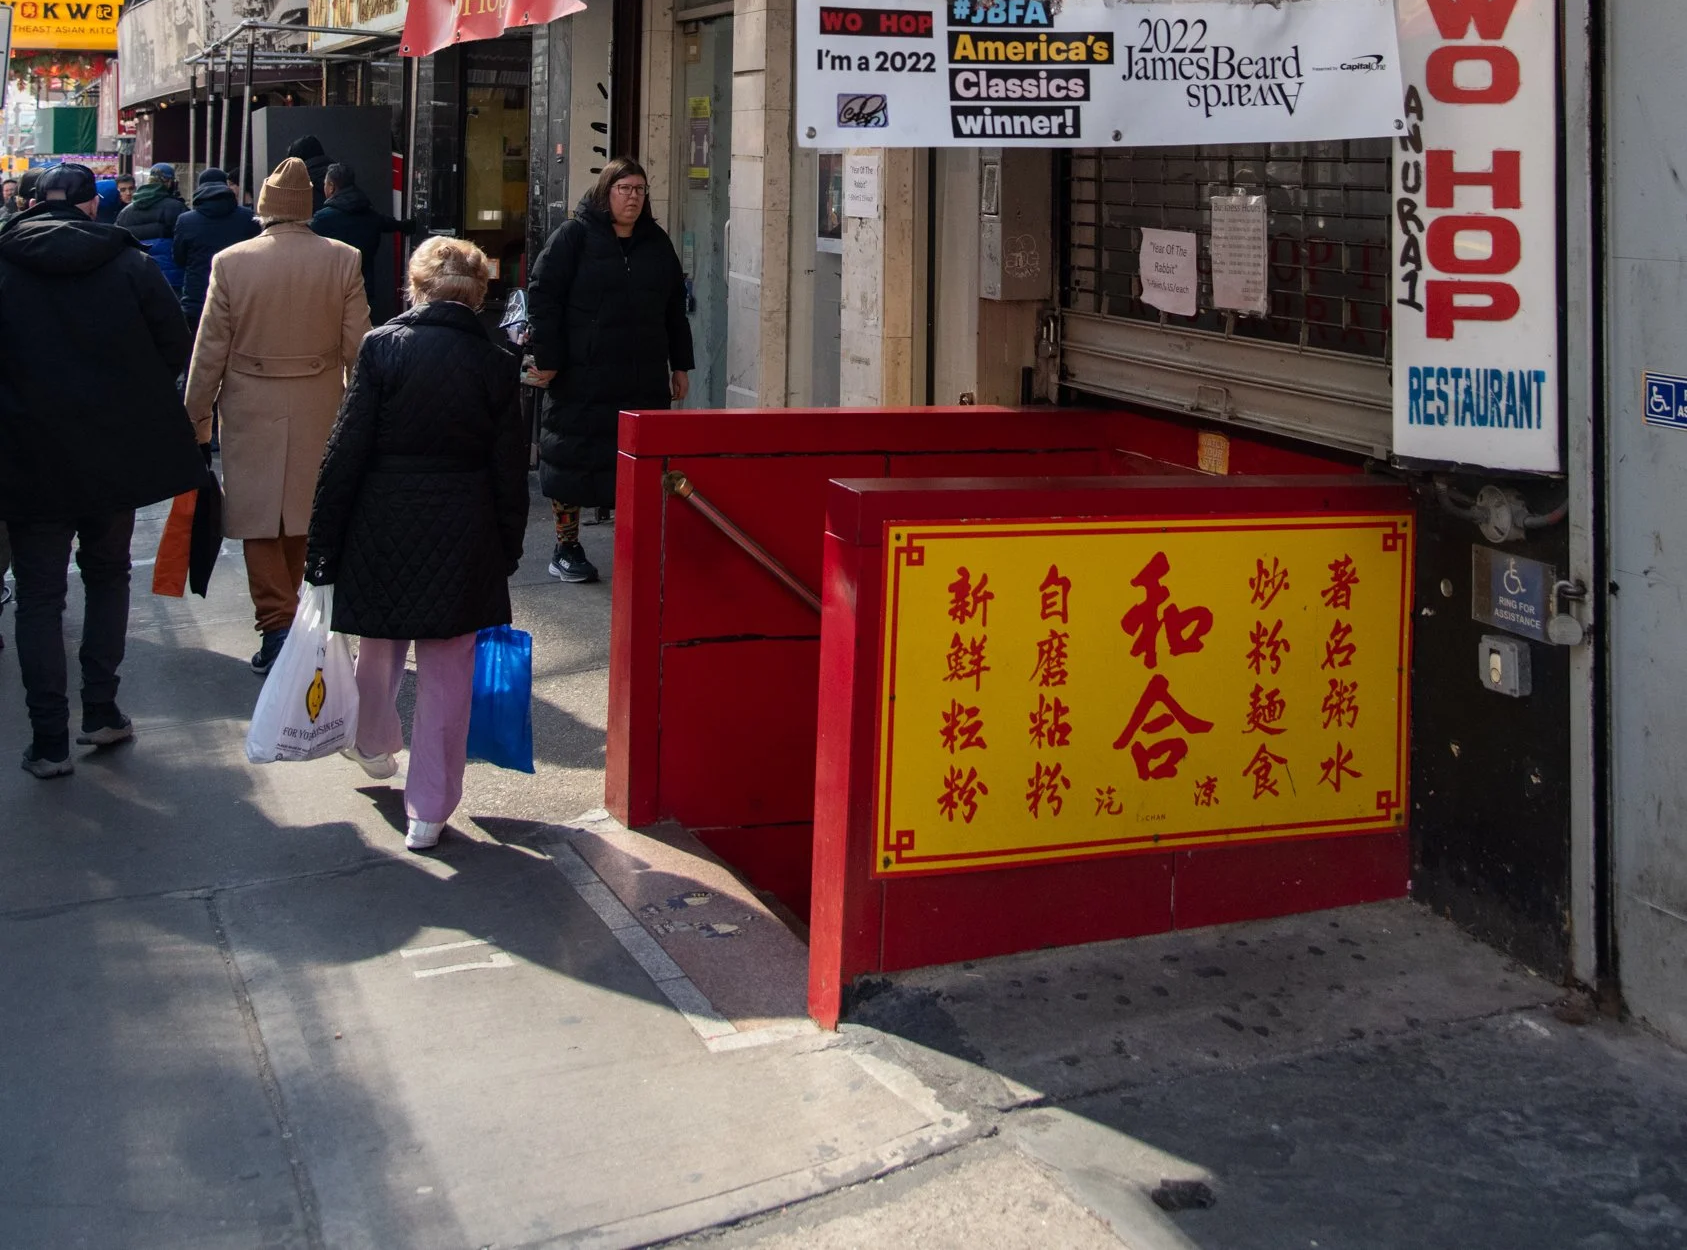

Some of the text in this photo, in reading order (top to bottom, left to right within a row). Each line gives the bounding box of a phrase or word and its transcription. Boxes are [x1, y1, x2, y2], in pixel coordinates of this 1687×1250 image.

[55, 25, 85, 34] ASIAN
[822, 11, 932, 35] WO HOP
[1138, 18, 1207, 54] 2022
[817, 49, 936, 73] I'm a 2022
[954, 34, 1109, 61] America's
[955, 70, 1085, 98] Classics
[1186, 82, 1304, 118] Awards
[957, 107, 1074, 135] winner!
[1426, 150, 1523, 340] HOP
[1408, 366, 1546, 429] RESTAURANT
[1494, 608, 1542, 629] ASSISTANCE
[1499, 596, 1535, 615] RING FOR
[1112, 551, 1214, 782] 和合
[283, 727, 298, 738] FOR
